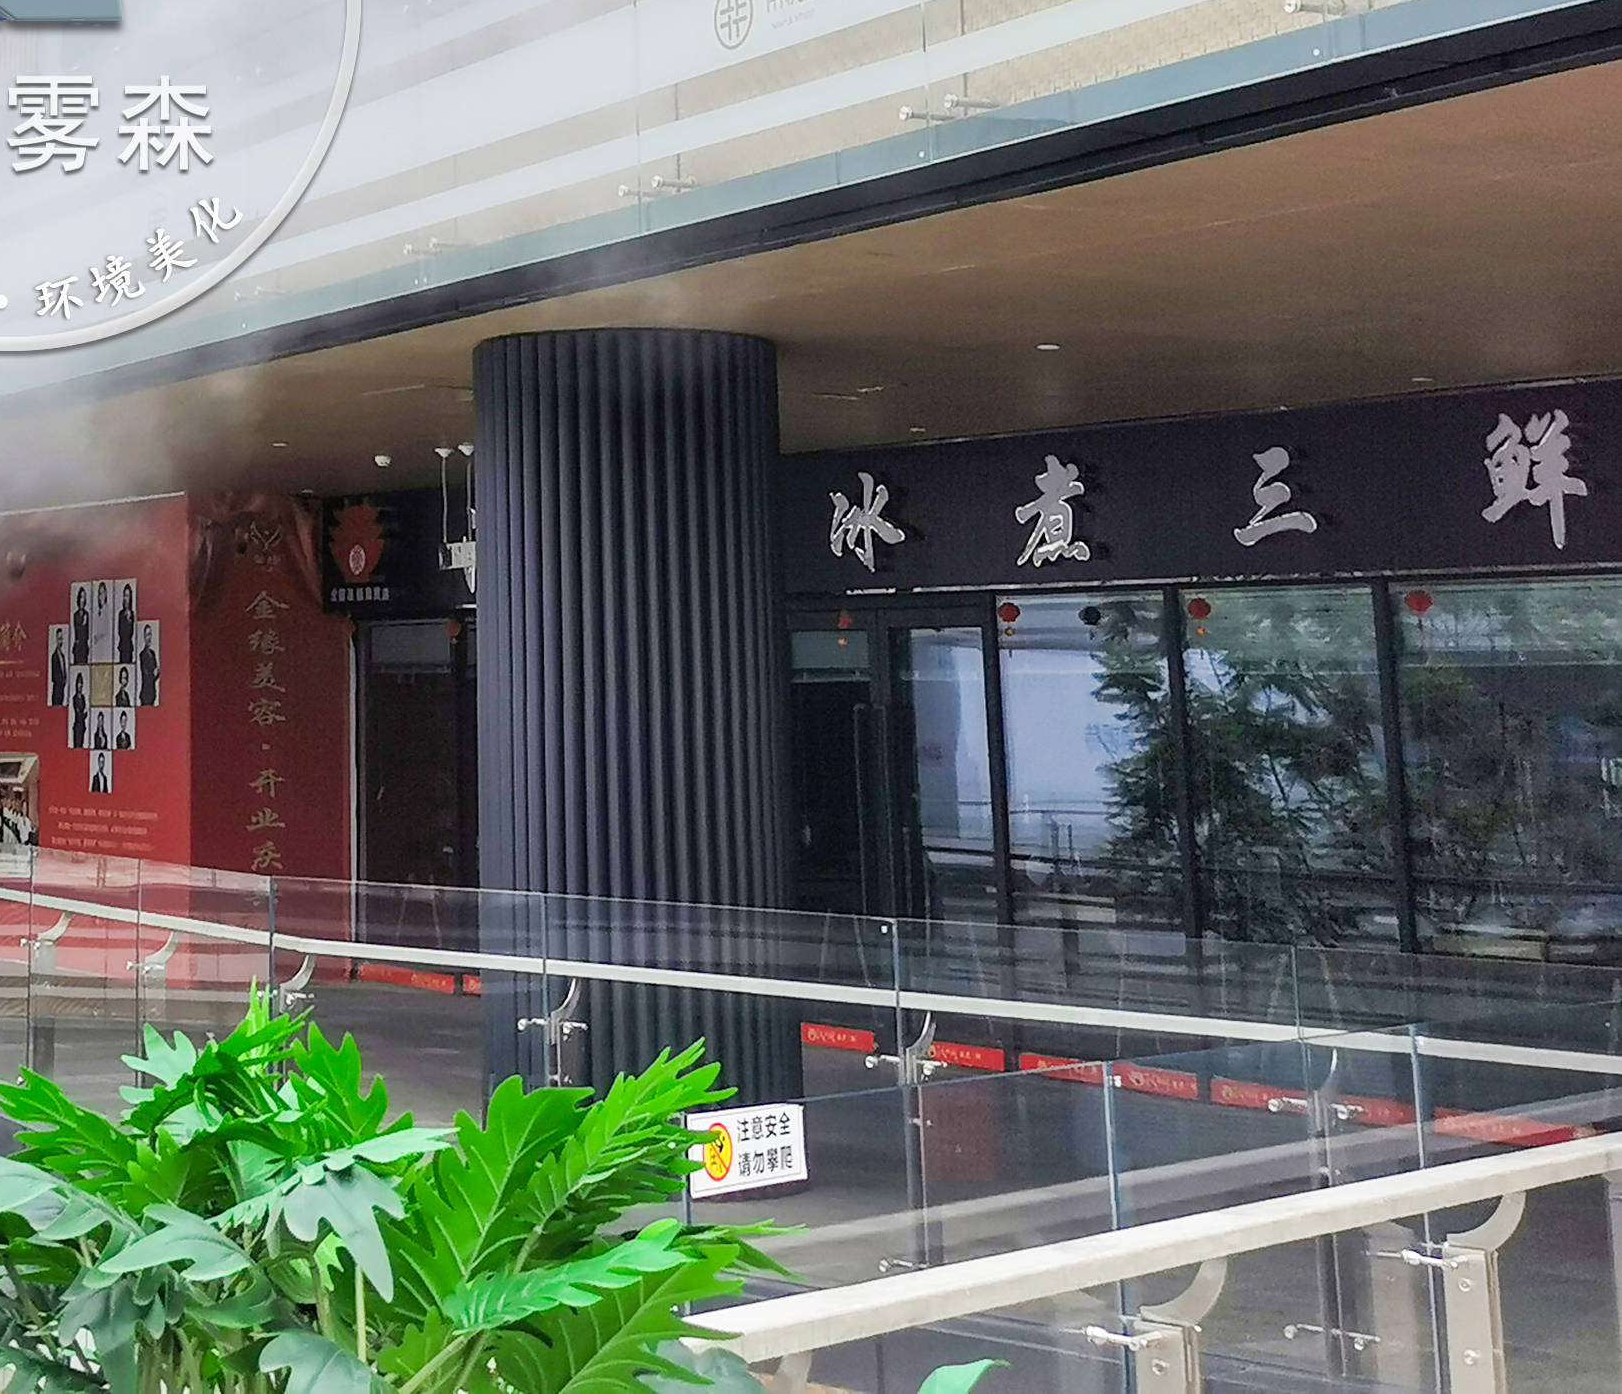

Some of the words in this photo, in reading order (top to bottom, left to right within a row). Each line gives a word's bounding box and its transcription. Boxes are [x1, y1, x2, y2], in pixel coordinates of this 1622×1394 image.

[829, 408, 1588, 572] 冰煮三鲜
[737, 1112, 790, 1143] 注意安全
[738, 1146, 793, 1177] 请勿攀爬
